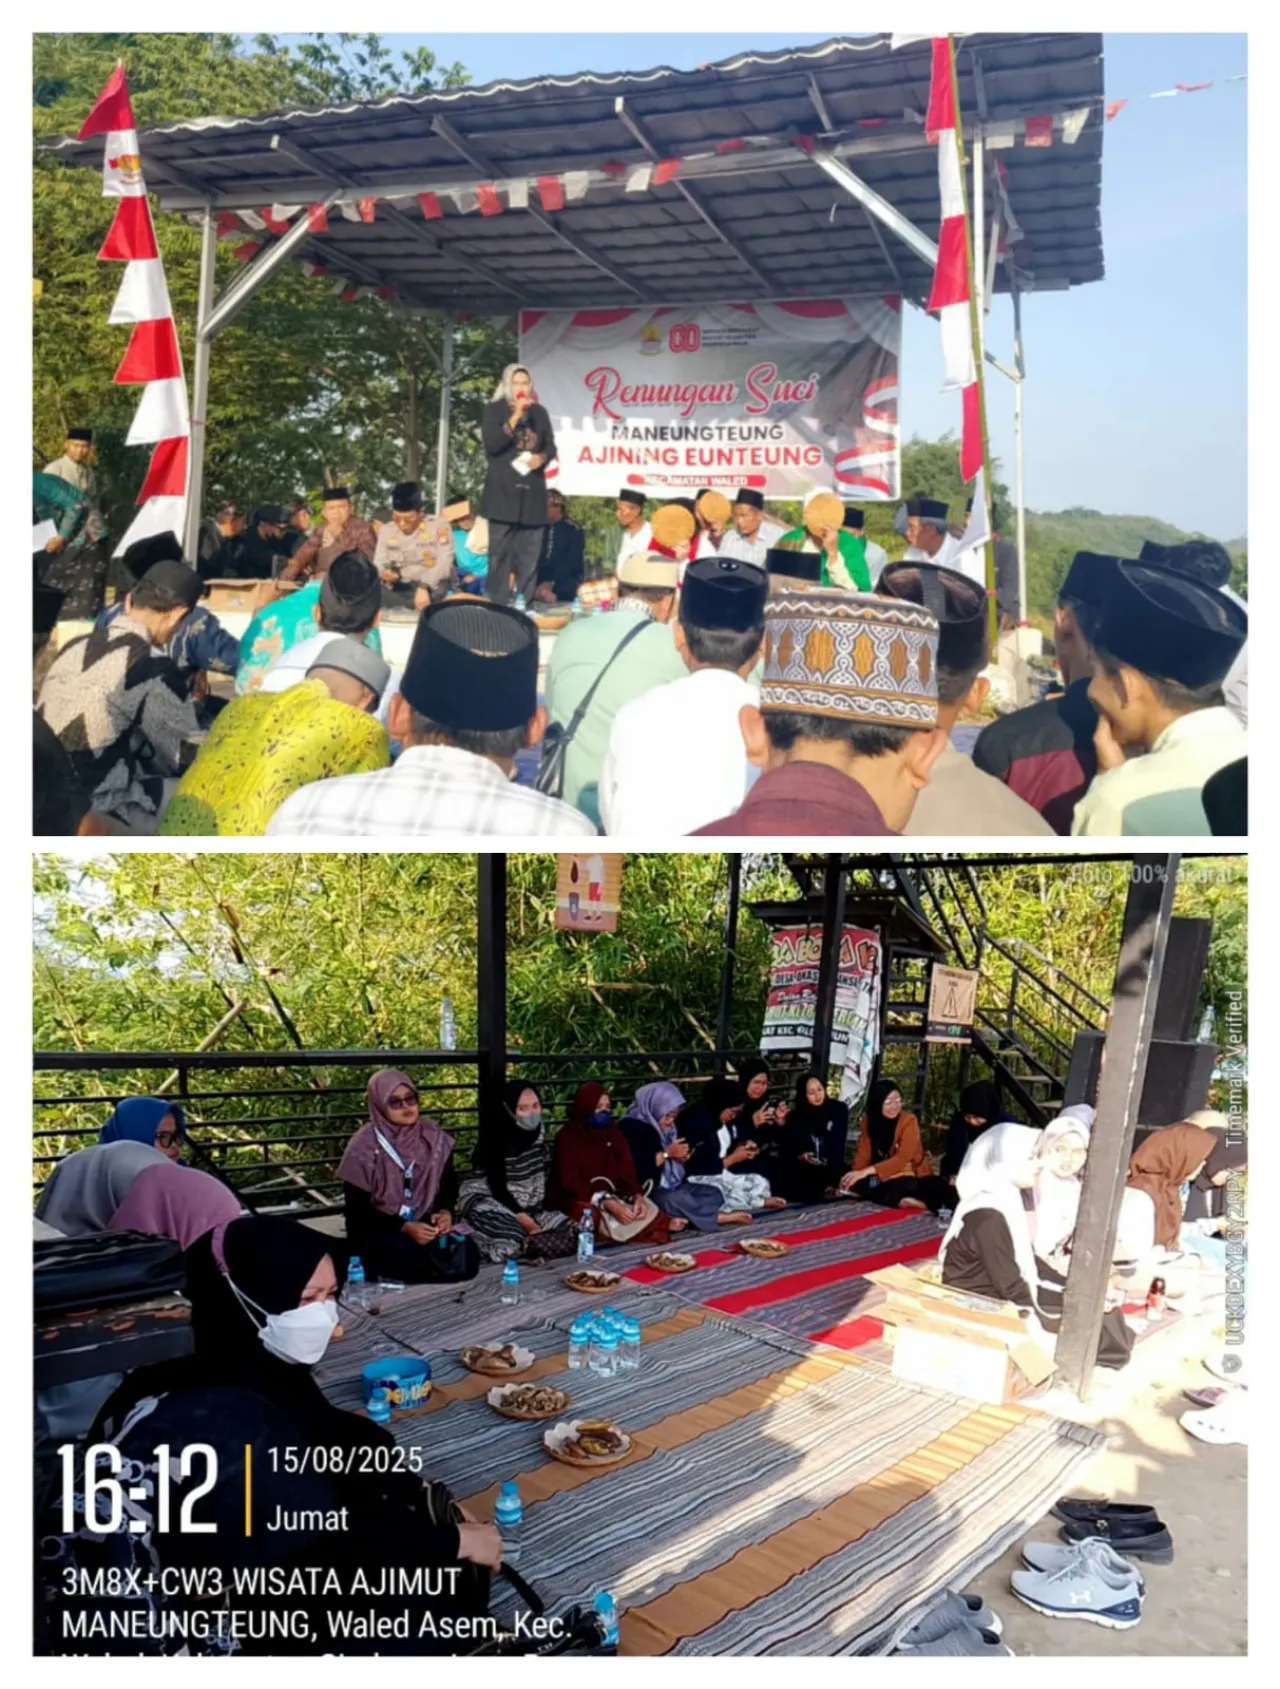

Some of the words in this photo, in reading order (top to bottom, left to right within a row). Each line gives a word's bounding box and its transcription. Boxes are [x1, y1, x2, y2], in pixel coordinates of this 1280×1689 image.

[584, 365, 734, 421] Renungan
[744, 361, 820, 415] Suci
[611, 424, 784, 441] MANEUNGTEUNG
[577, 446, 679, 466] AJINING
[684, 445, 823, 467] EUNTEUNG
